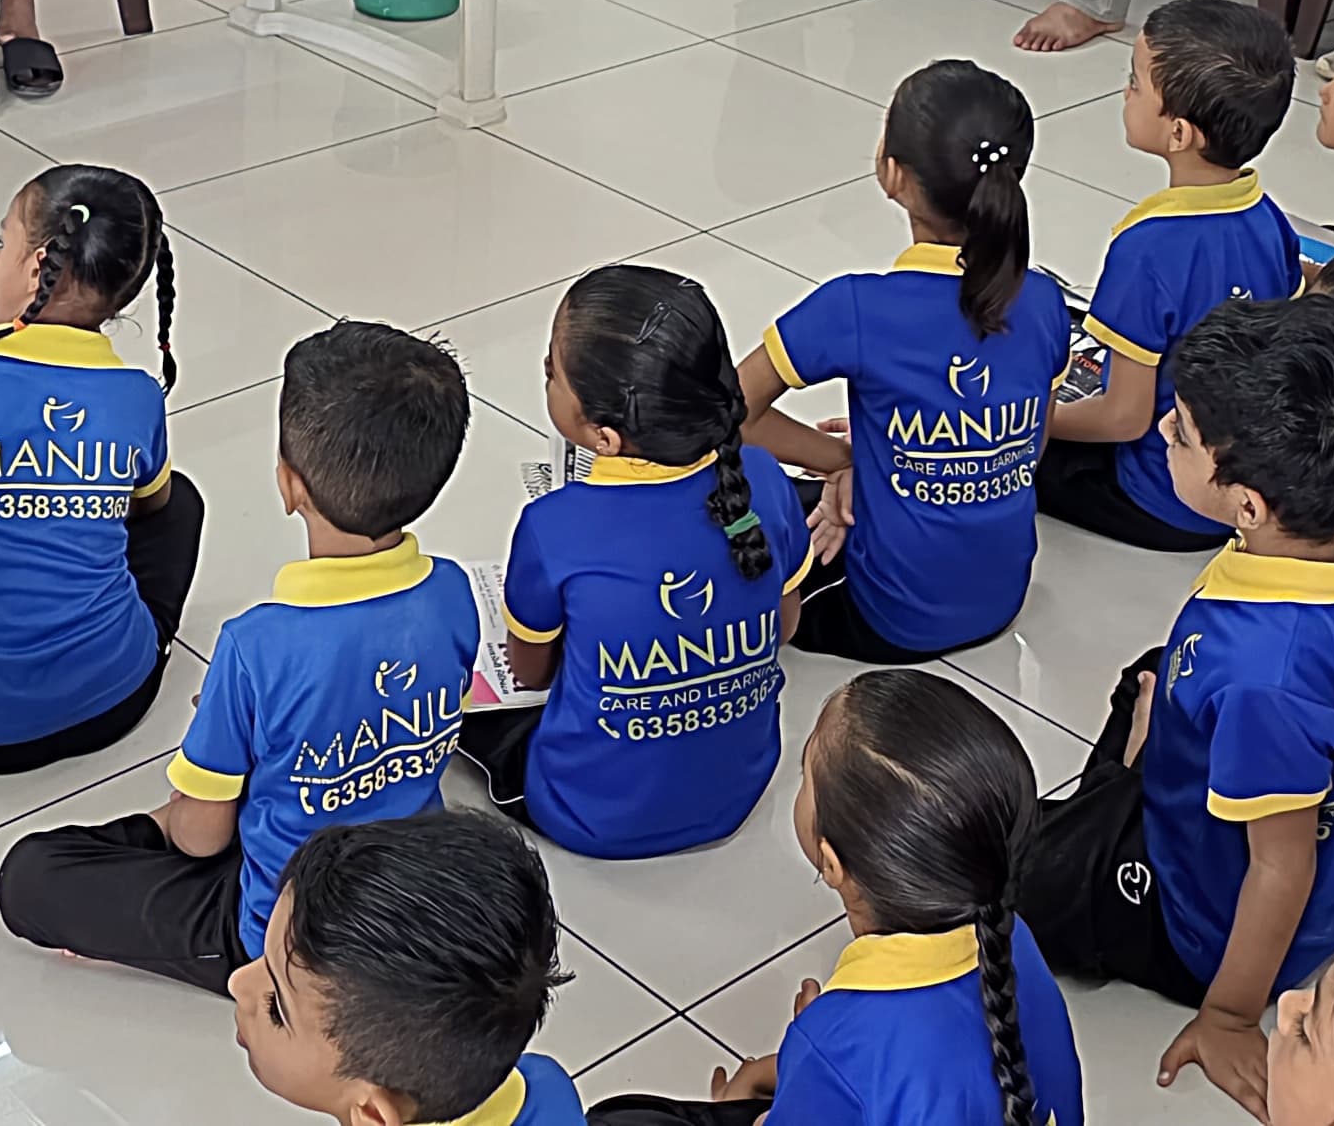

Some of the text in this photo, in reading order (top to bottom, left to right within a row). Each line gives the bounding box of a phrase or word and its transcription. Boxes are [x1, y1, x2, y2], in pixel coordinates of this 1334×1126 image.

[887, 396, 1040, 447] MANJUL
[893, 455, 936, 476] CARE
[942, 461, 979, 477] AND
[599, 610, 777, 681] MANJUL
[599, 663, 780, 712] CARE AND LEARNIN
